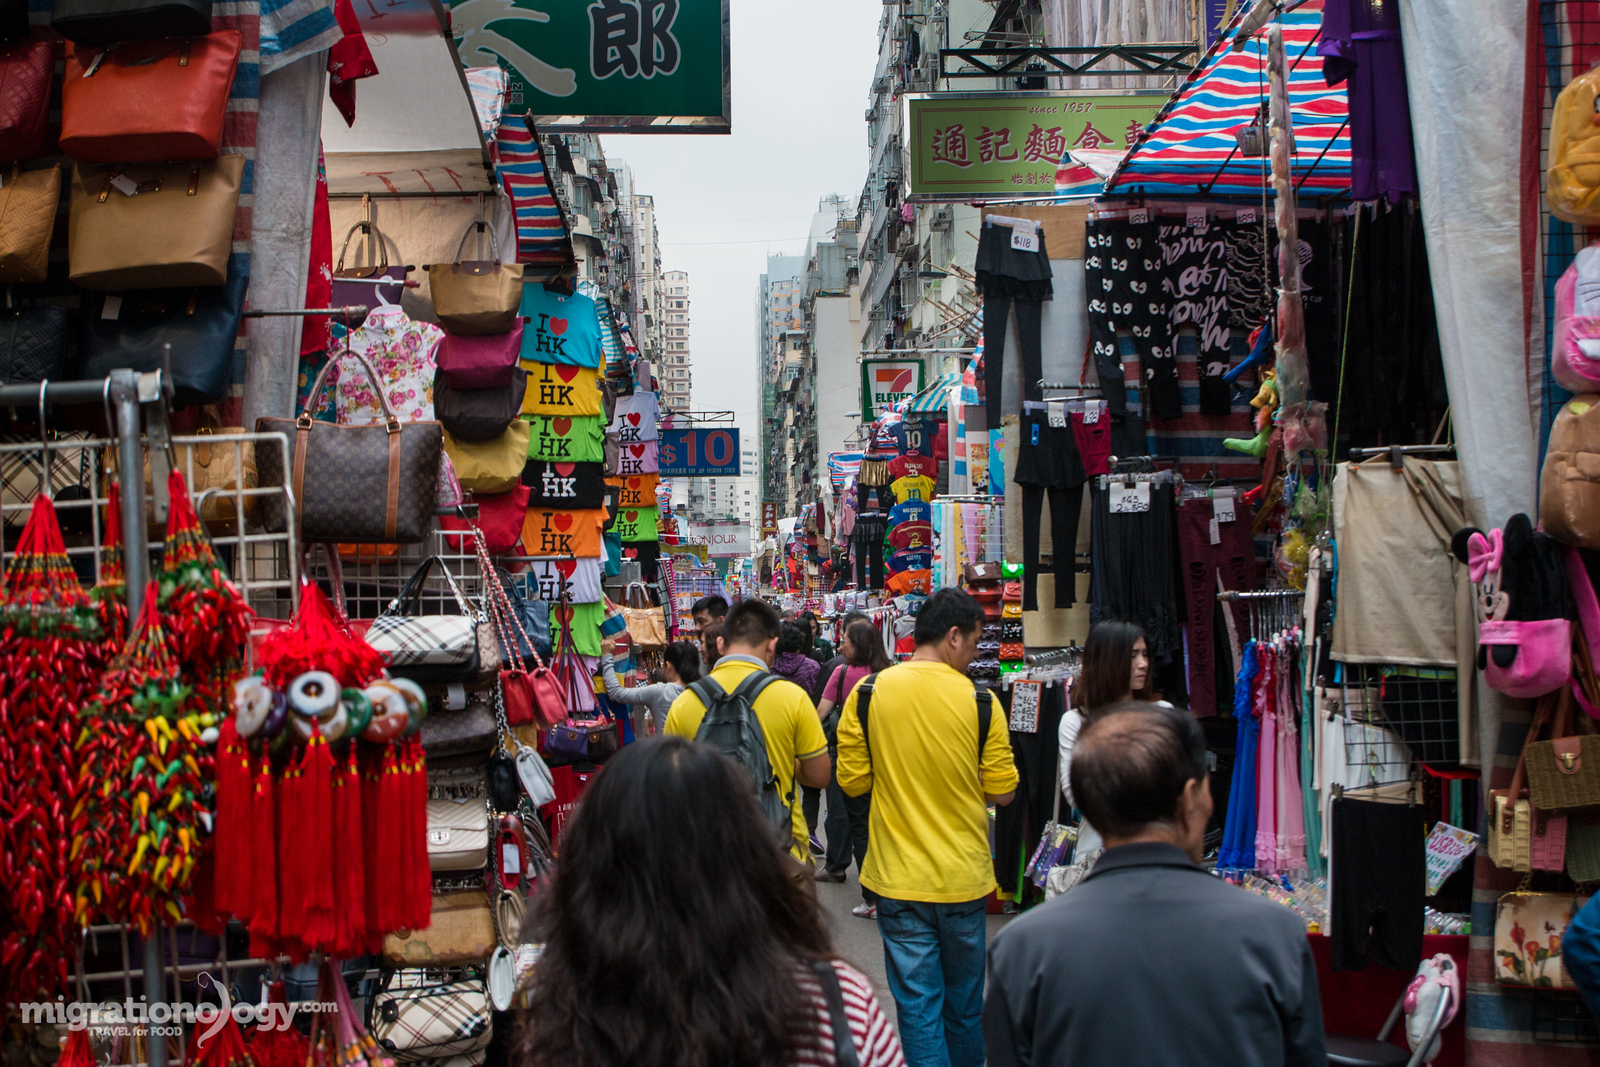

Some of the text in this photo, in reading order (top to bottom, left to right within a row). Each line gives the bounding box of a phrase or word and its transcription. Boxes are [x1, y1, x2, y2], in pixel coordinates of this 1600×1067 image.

[1030, 102, 1093, 114] since 1957
[1014, 237, 1032, 248] $118
[536, 313, 549, 333] I
[535, 334, 567, 356] HK
[540, 362, 553, 383] I
[876, 368, 912, 393] 7
[539, 385, 574, 406] HK
[540, 416, 551, 437] I
[618, 414, 628, 428] I
[618, 427, 641, 441] HK
[905, 430, 922, 449] 10
[538, 437, 572, 457] HK
[620, 445, 629, 459] I
[660, 430, 734, 467] $10
[621, 460, 643, 474] HK
[542, 477, 577, 497] HK
[620, 477, 628, 490] I
[620, 491, 642, 503] HK
[541, 512, 553, 532] I
[617, 510, 625, 524] I
[1216, 511, 1234, 521] $79
[616, 524, 639, 536] HK
[540, 533, 573, 552] HK
